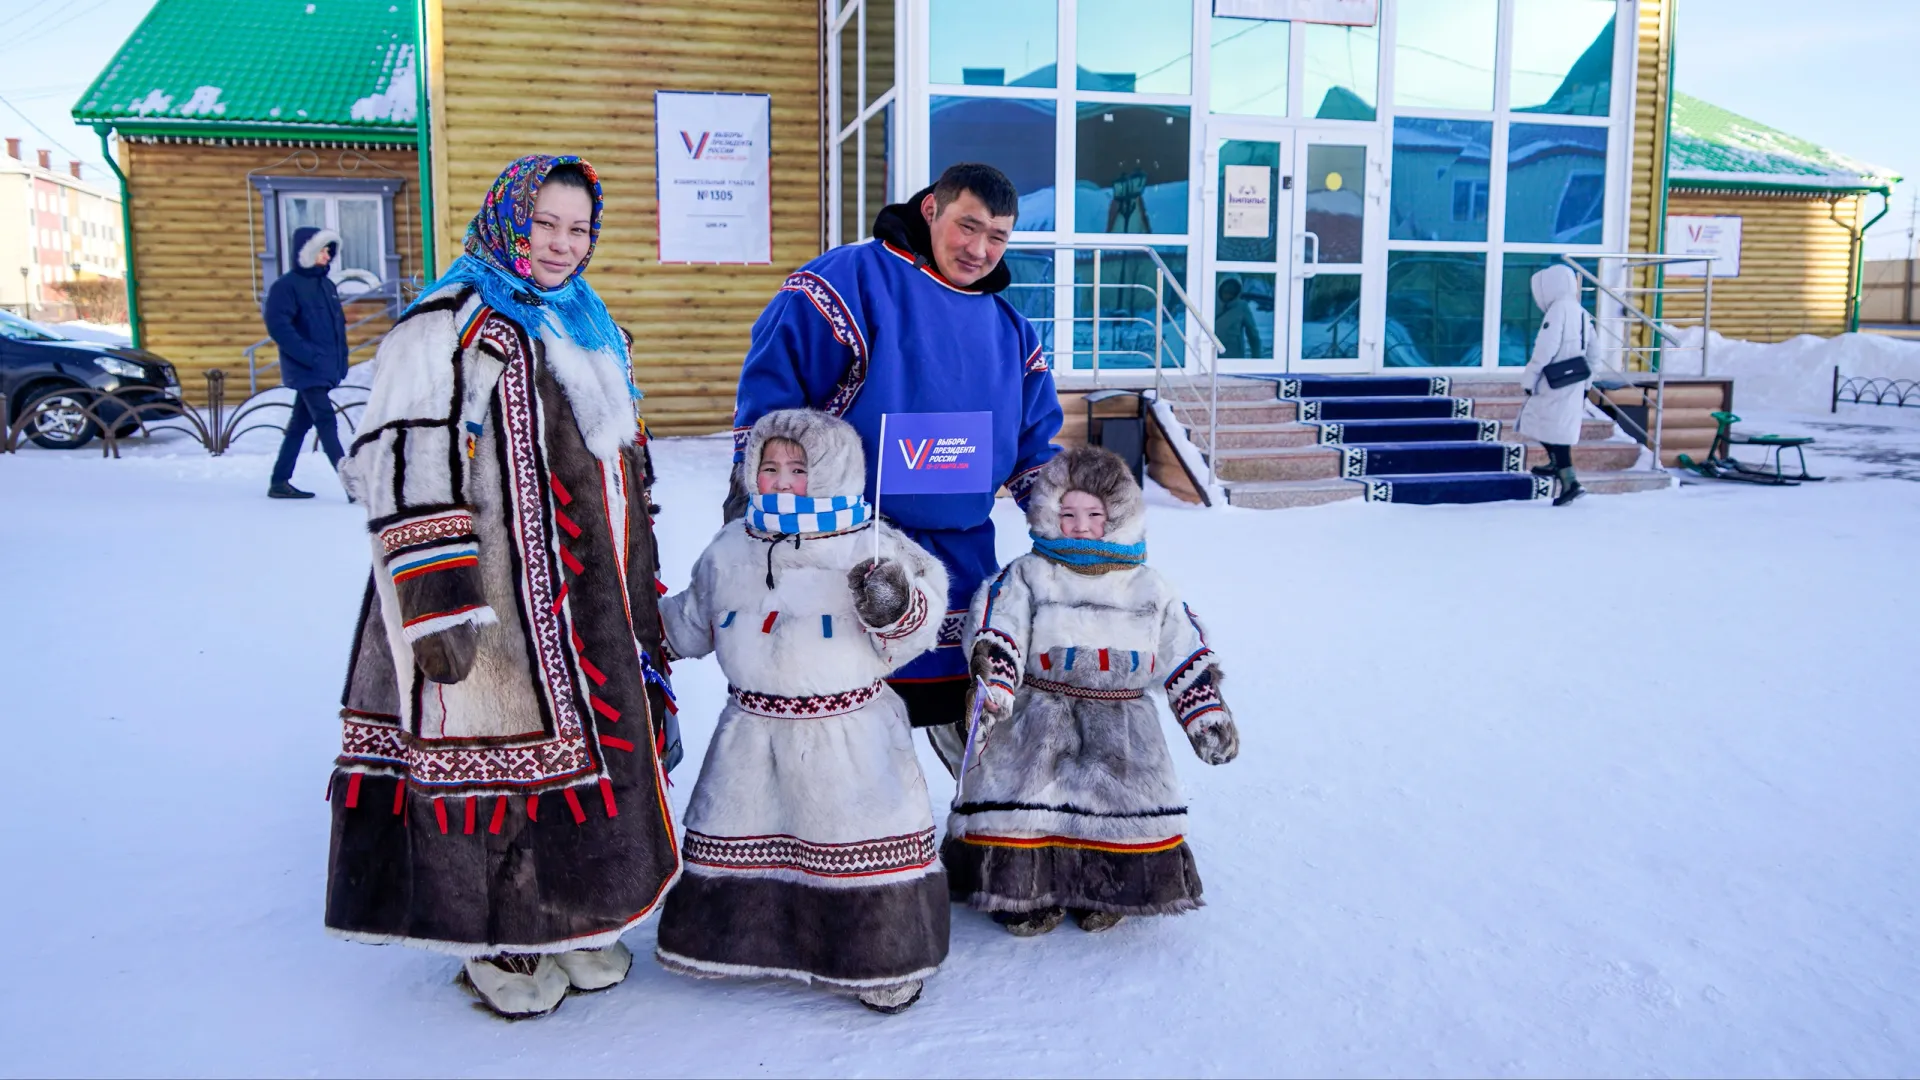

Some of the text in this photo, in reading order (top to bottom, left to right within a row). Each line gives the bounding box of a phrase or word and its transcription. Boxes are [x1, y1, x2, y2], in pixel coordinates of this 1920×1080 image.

[936, 438, 968, 446] ВЫБОРЫ
[932, 446, 976, 455] ПРЕЗИДЕНТА
[928, 455, 958, 463] РОССИИ
